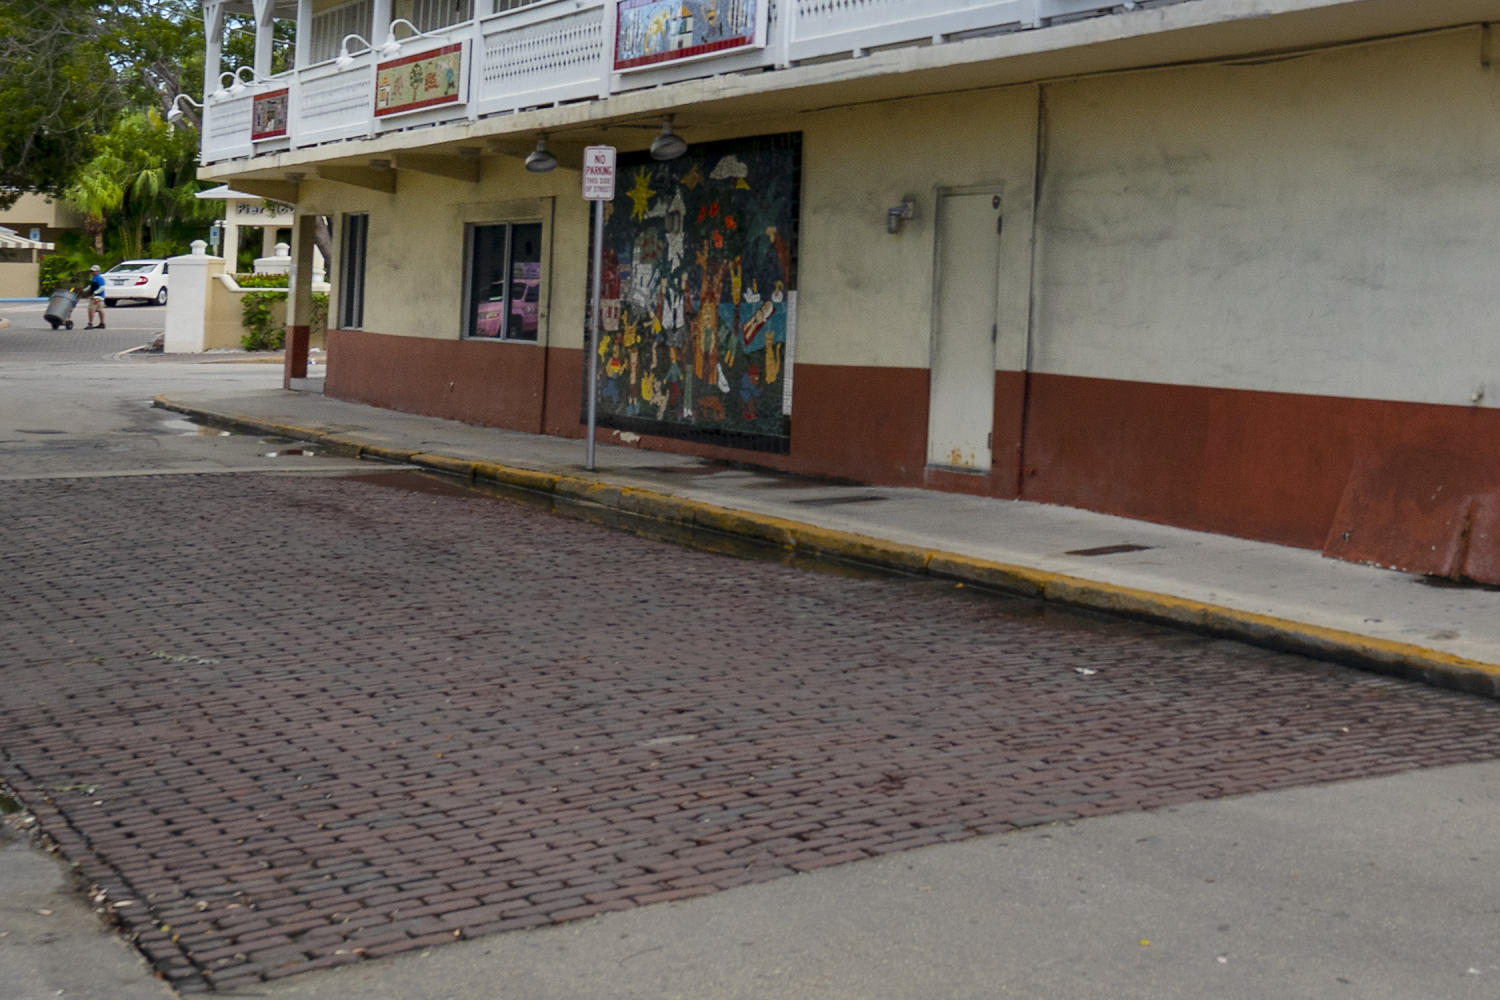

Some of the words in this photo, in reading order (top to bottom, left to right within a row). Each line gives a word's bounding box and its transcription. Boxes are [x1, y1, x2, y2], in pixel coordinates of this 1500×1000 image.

[594, 154, 606, 164] NO
[586, 166, 612, 175] PARKING
[237, 204, 264, 214] Pier
